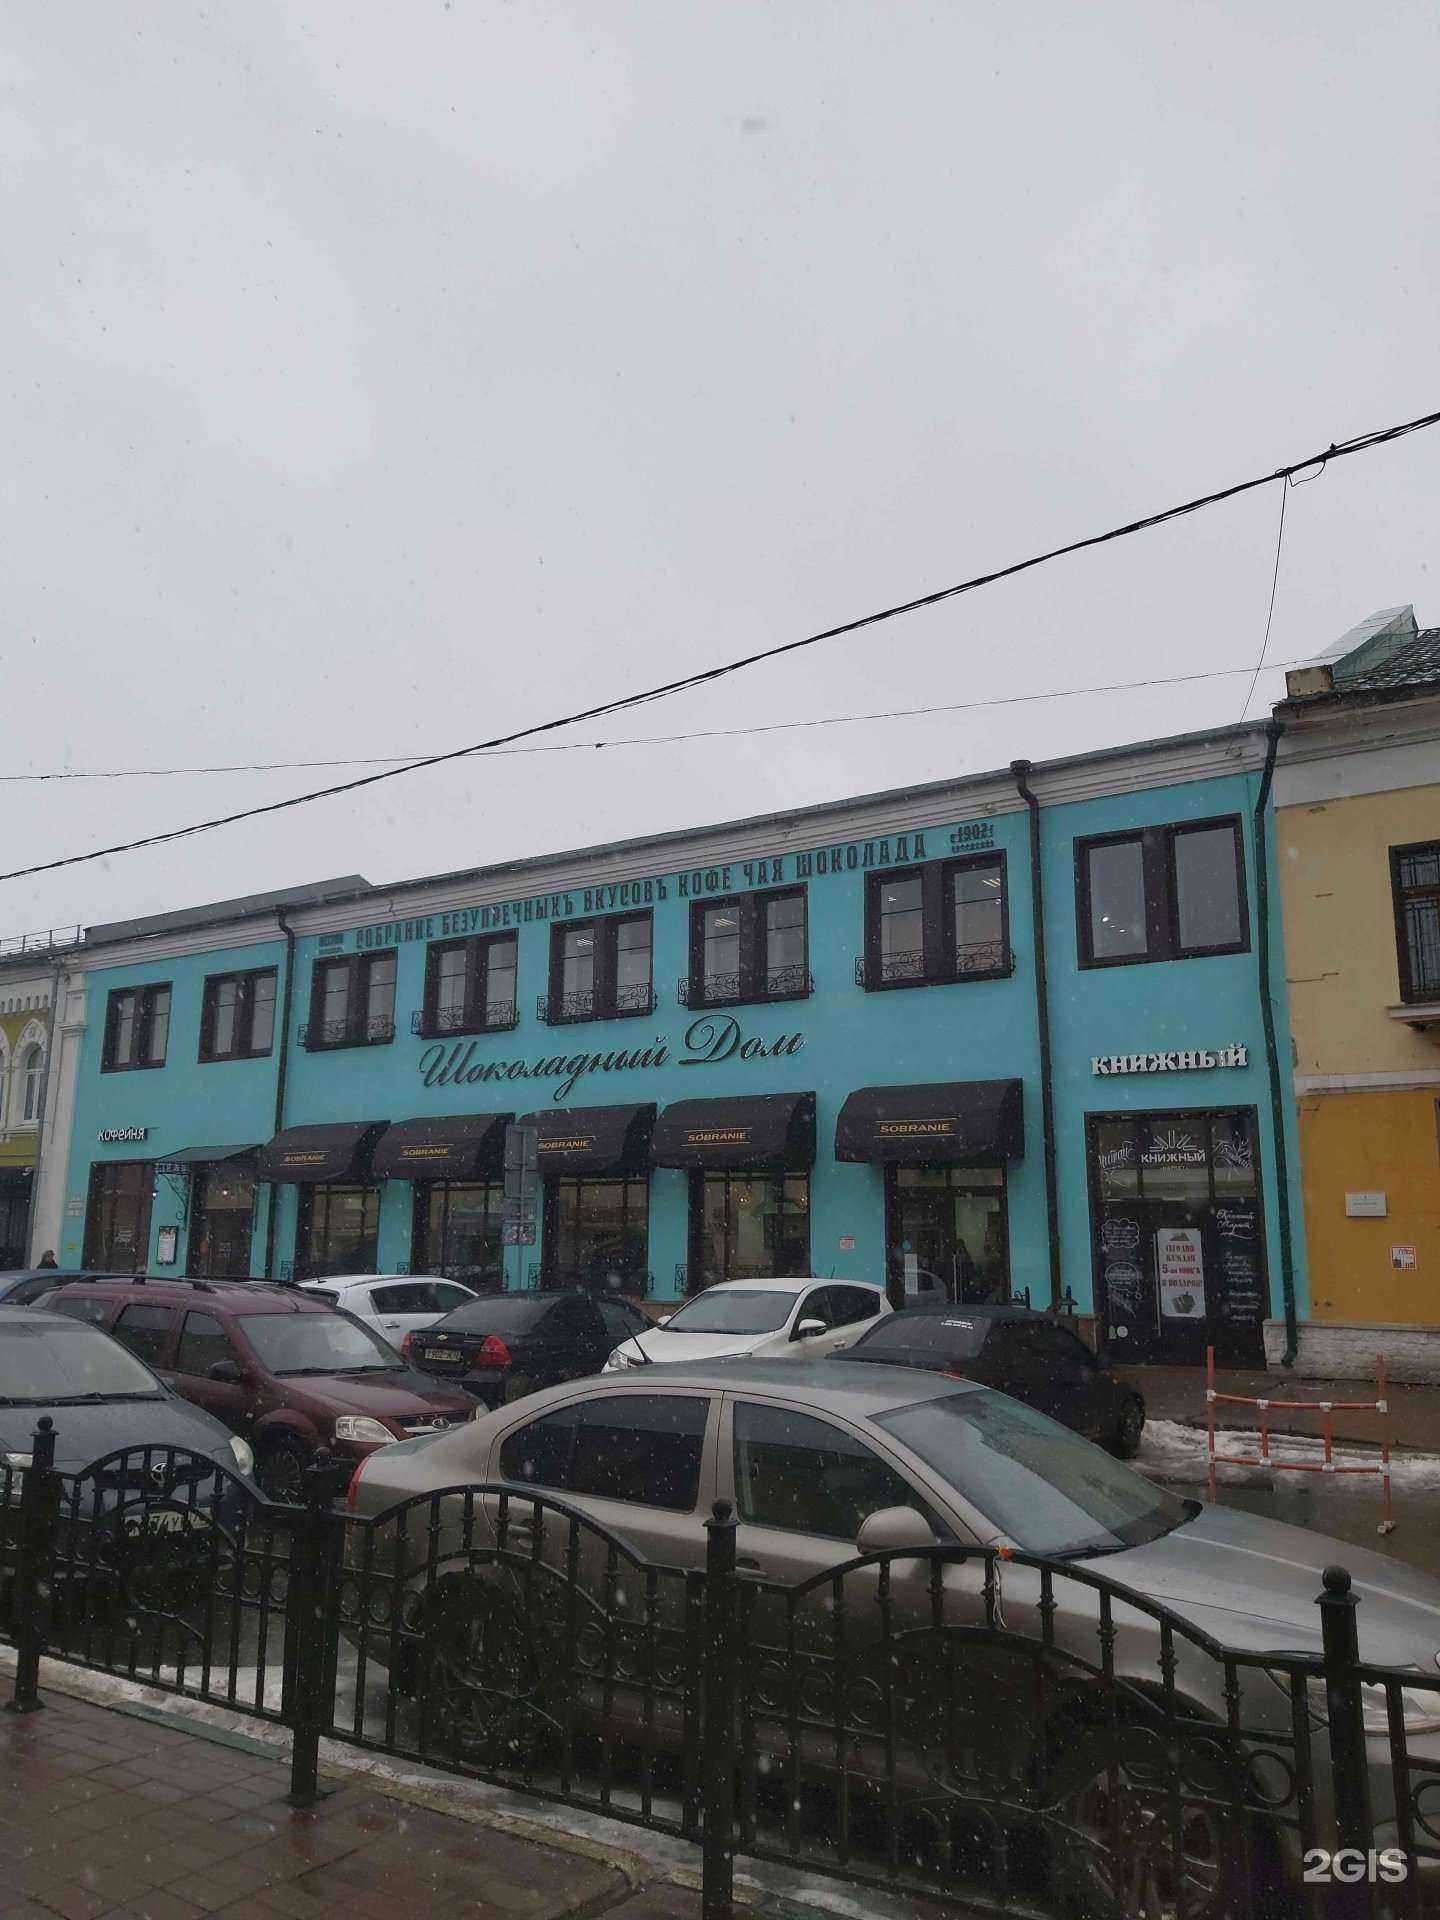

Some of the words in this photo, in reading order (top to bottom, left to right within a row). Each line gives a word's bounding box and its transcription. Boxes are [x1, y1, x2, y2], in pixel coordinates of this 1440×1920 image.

[442, 894, 573, 935] БЕЗУПРЕЧНЫХЪ
[584, 878, 667, 912] ВКУСОВЪ
[679, 865, 732, 897] КОФЕ
[743, 857, 784, 887] ЧАЯ
[796, 834, 927, 878] ШОКОЛАДА
[1091, 1042, 1249, 1075] КНИЖНЫЙ
[418, 1035, 671, 1101] Шоколадный
[880, 1123, 951, 1133] SOBRANIE
[687, 1132, 747, 1142] SOBRANIE
[537, 1139, 590, 1149] SOBRANIE
[402, 1147, 449, 1157] SOBRANIE
[1140, 1150, 1206, 1163] КНИЖНЫЙ
[283, 1153, 325, 1163] SOBRANIE
